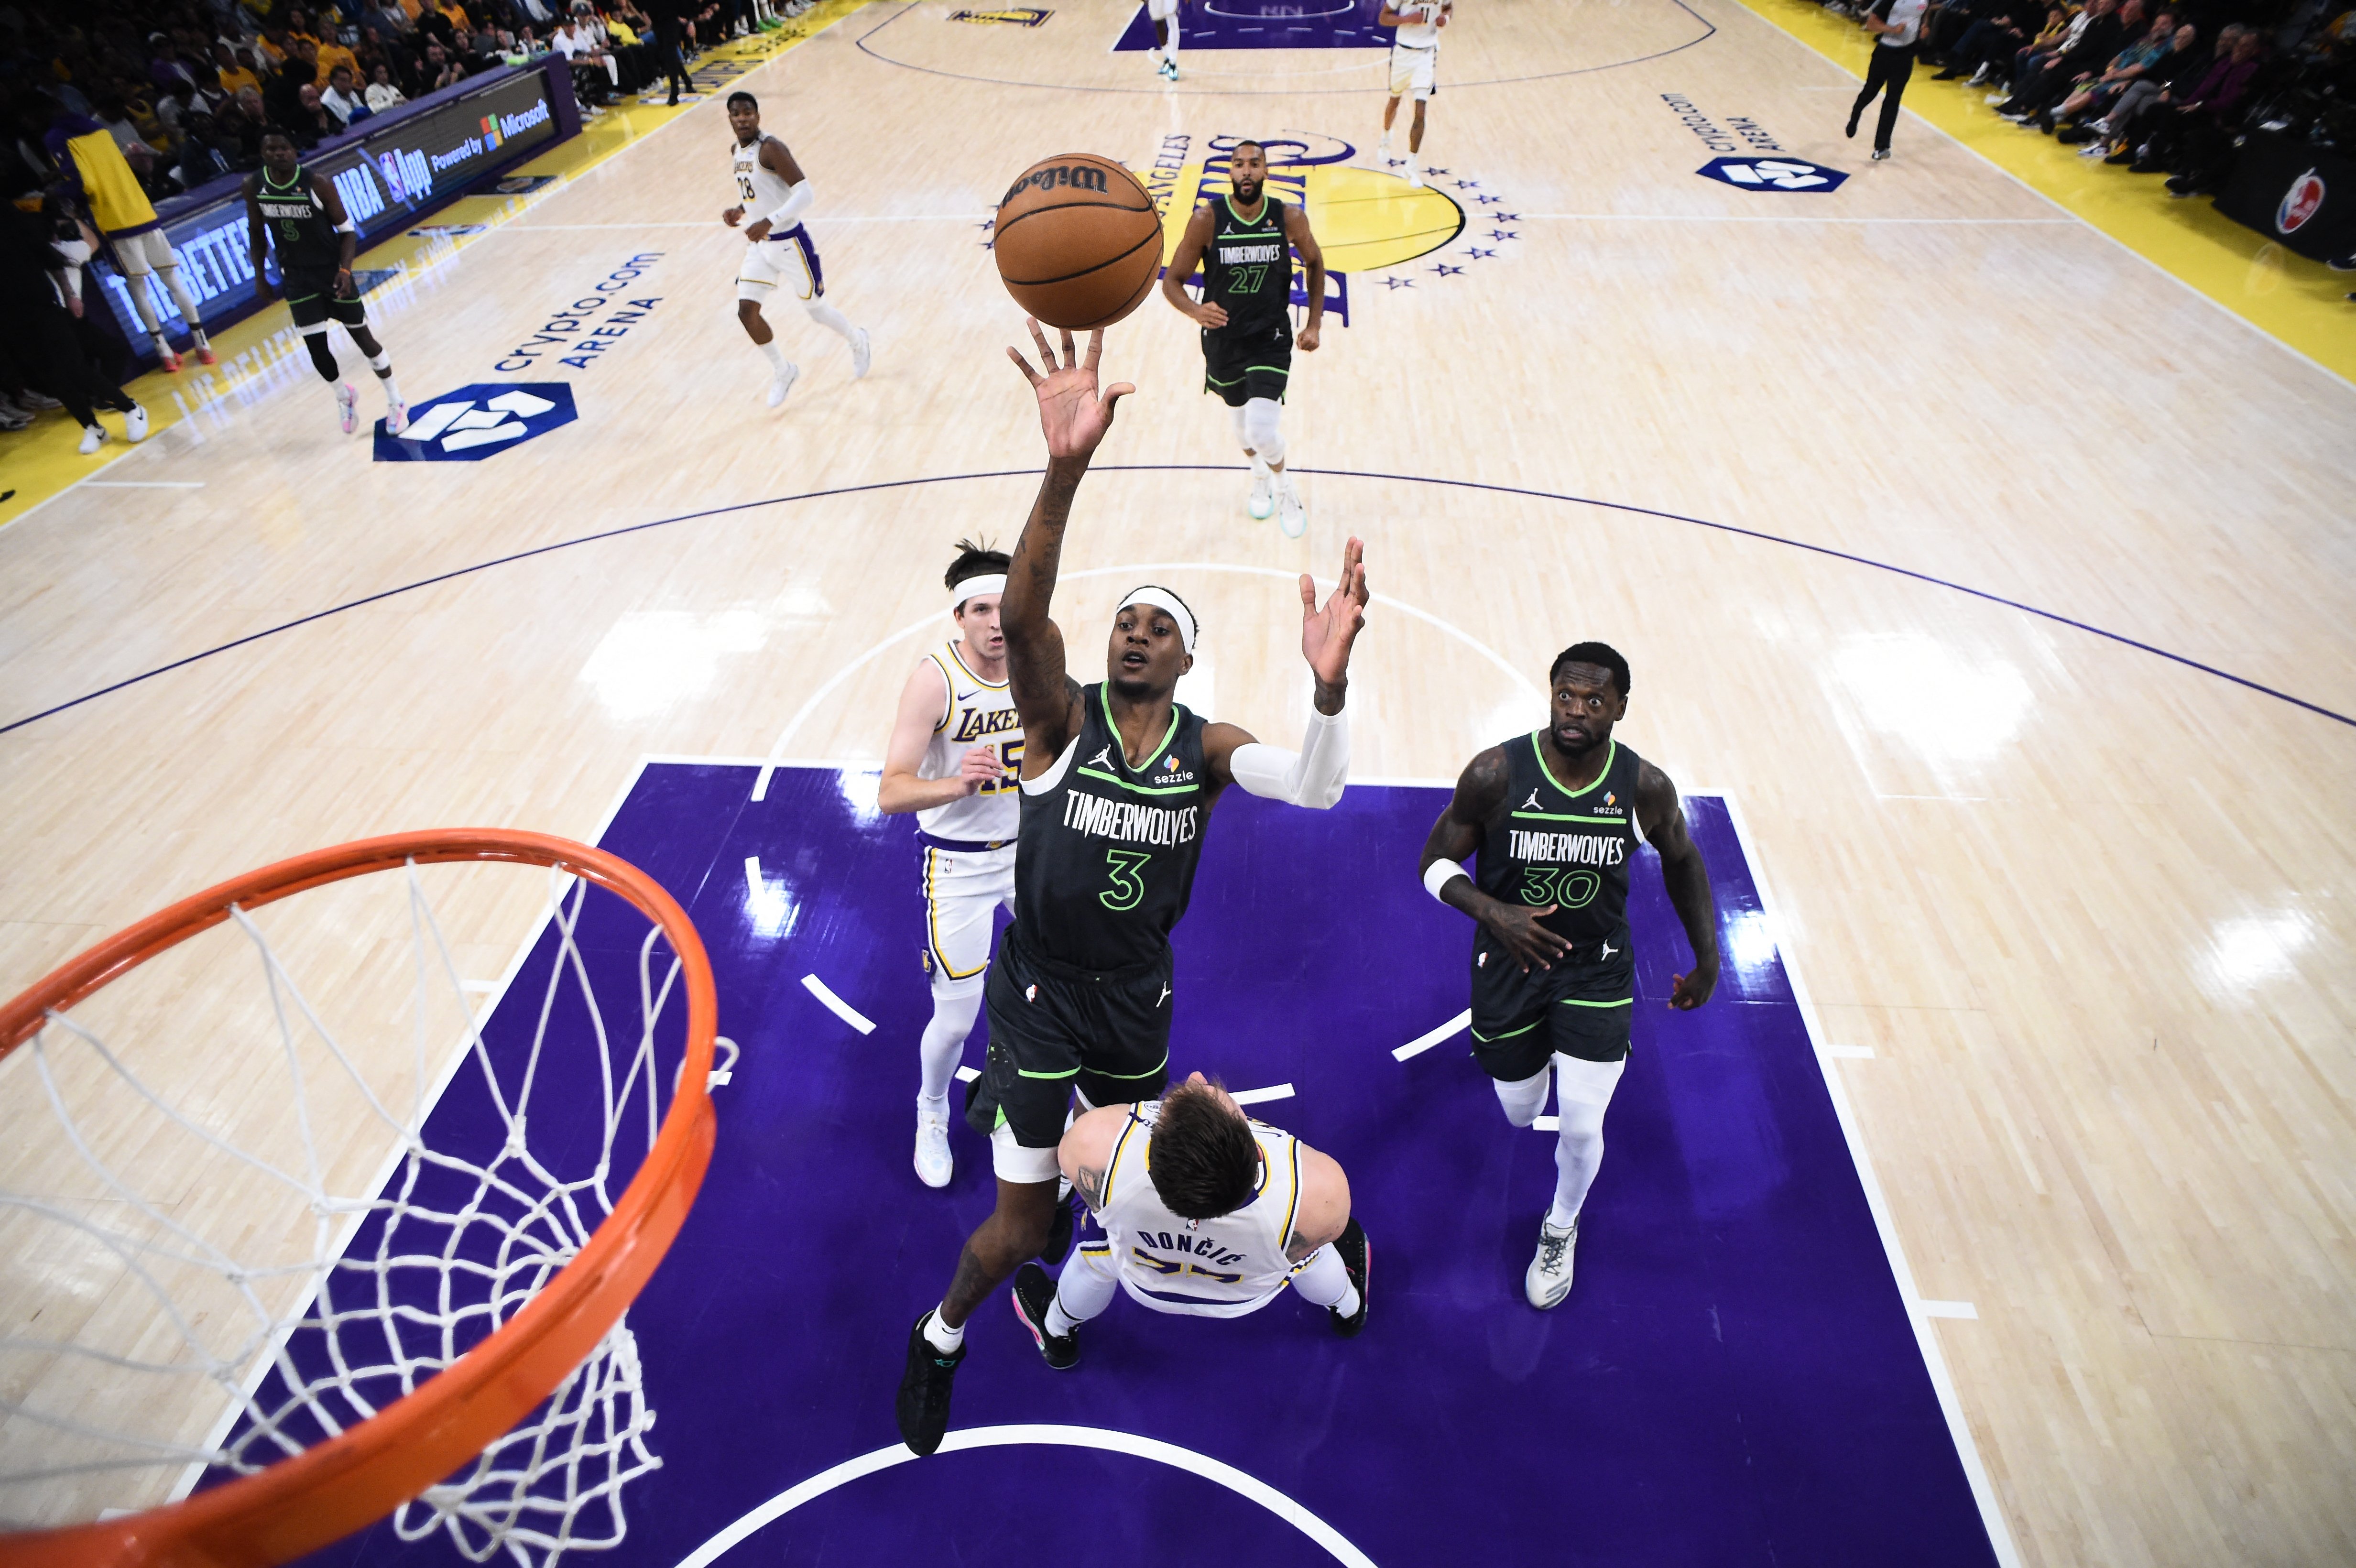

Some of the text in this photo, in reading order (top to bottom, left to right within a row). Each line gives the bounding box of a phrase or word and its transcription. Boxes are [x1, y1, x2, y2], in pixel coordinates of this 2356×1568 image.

[1660, 94, 1736, 151] crypto.com
[1726, 117, 1786, 152] ARENA
[333, 98, 550, 229] NBA App Powered by Microsoft
[1002, 165, 1108, 208] Wilson
[281, 219, 300, 241] 5
[1219, 244, 1280, 265] TIMBERWOLVES
[1228, 264, 1268, 294] 27
[494, 252, 665, 371] crypto.com
[557, 297, 664, 369] ARENA
[1154, 770, 1194, 784] sezzle
[1063, 789, 1198, 850] TIMBERWOLVES
[1593, 806, 1623, 815] sezzle
[1509, 829, 1625, 869] TIMBERWOLVES
[1099, 849, 1152, 910] 3
[1520, 867, 1601, 909] 30
[1137, 1230, 1247, 1266] DONČIĆ
